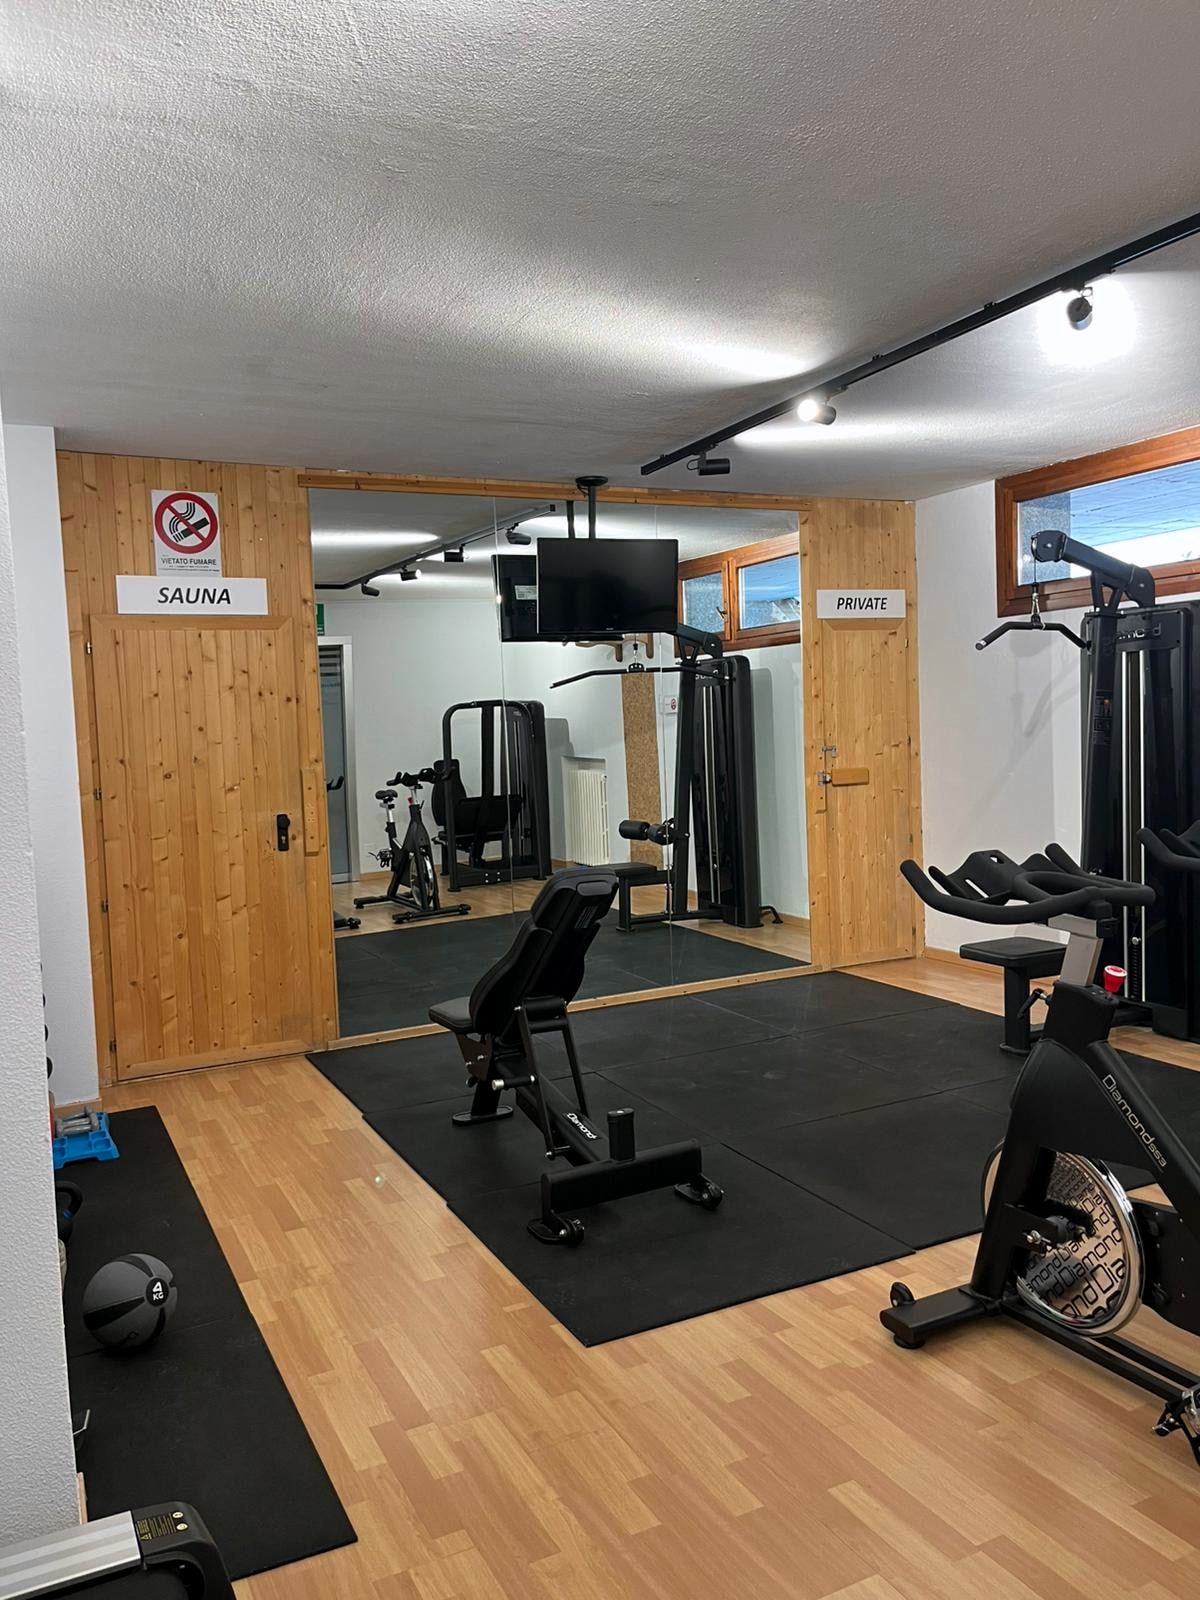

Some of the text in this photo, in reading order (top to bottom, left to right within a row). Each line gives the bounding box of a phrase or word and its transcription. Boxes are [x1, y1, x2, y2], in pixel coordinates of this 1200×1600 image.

[161, 557, 217, 566] VIETATO FUMARE
[157, 587, 231, 604] SAUNA
[836, 596, 888, 610] PRIVATE
[152, 1281, 163, 1292] 4
[152, 1291, 164, 1301] KG
